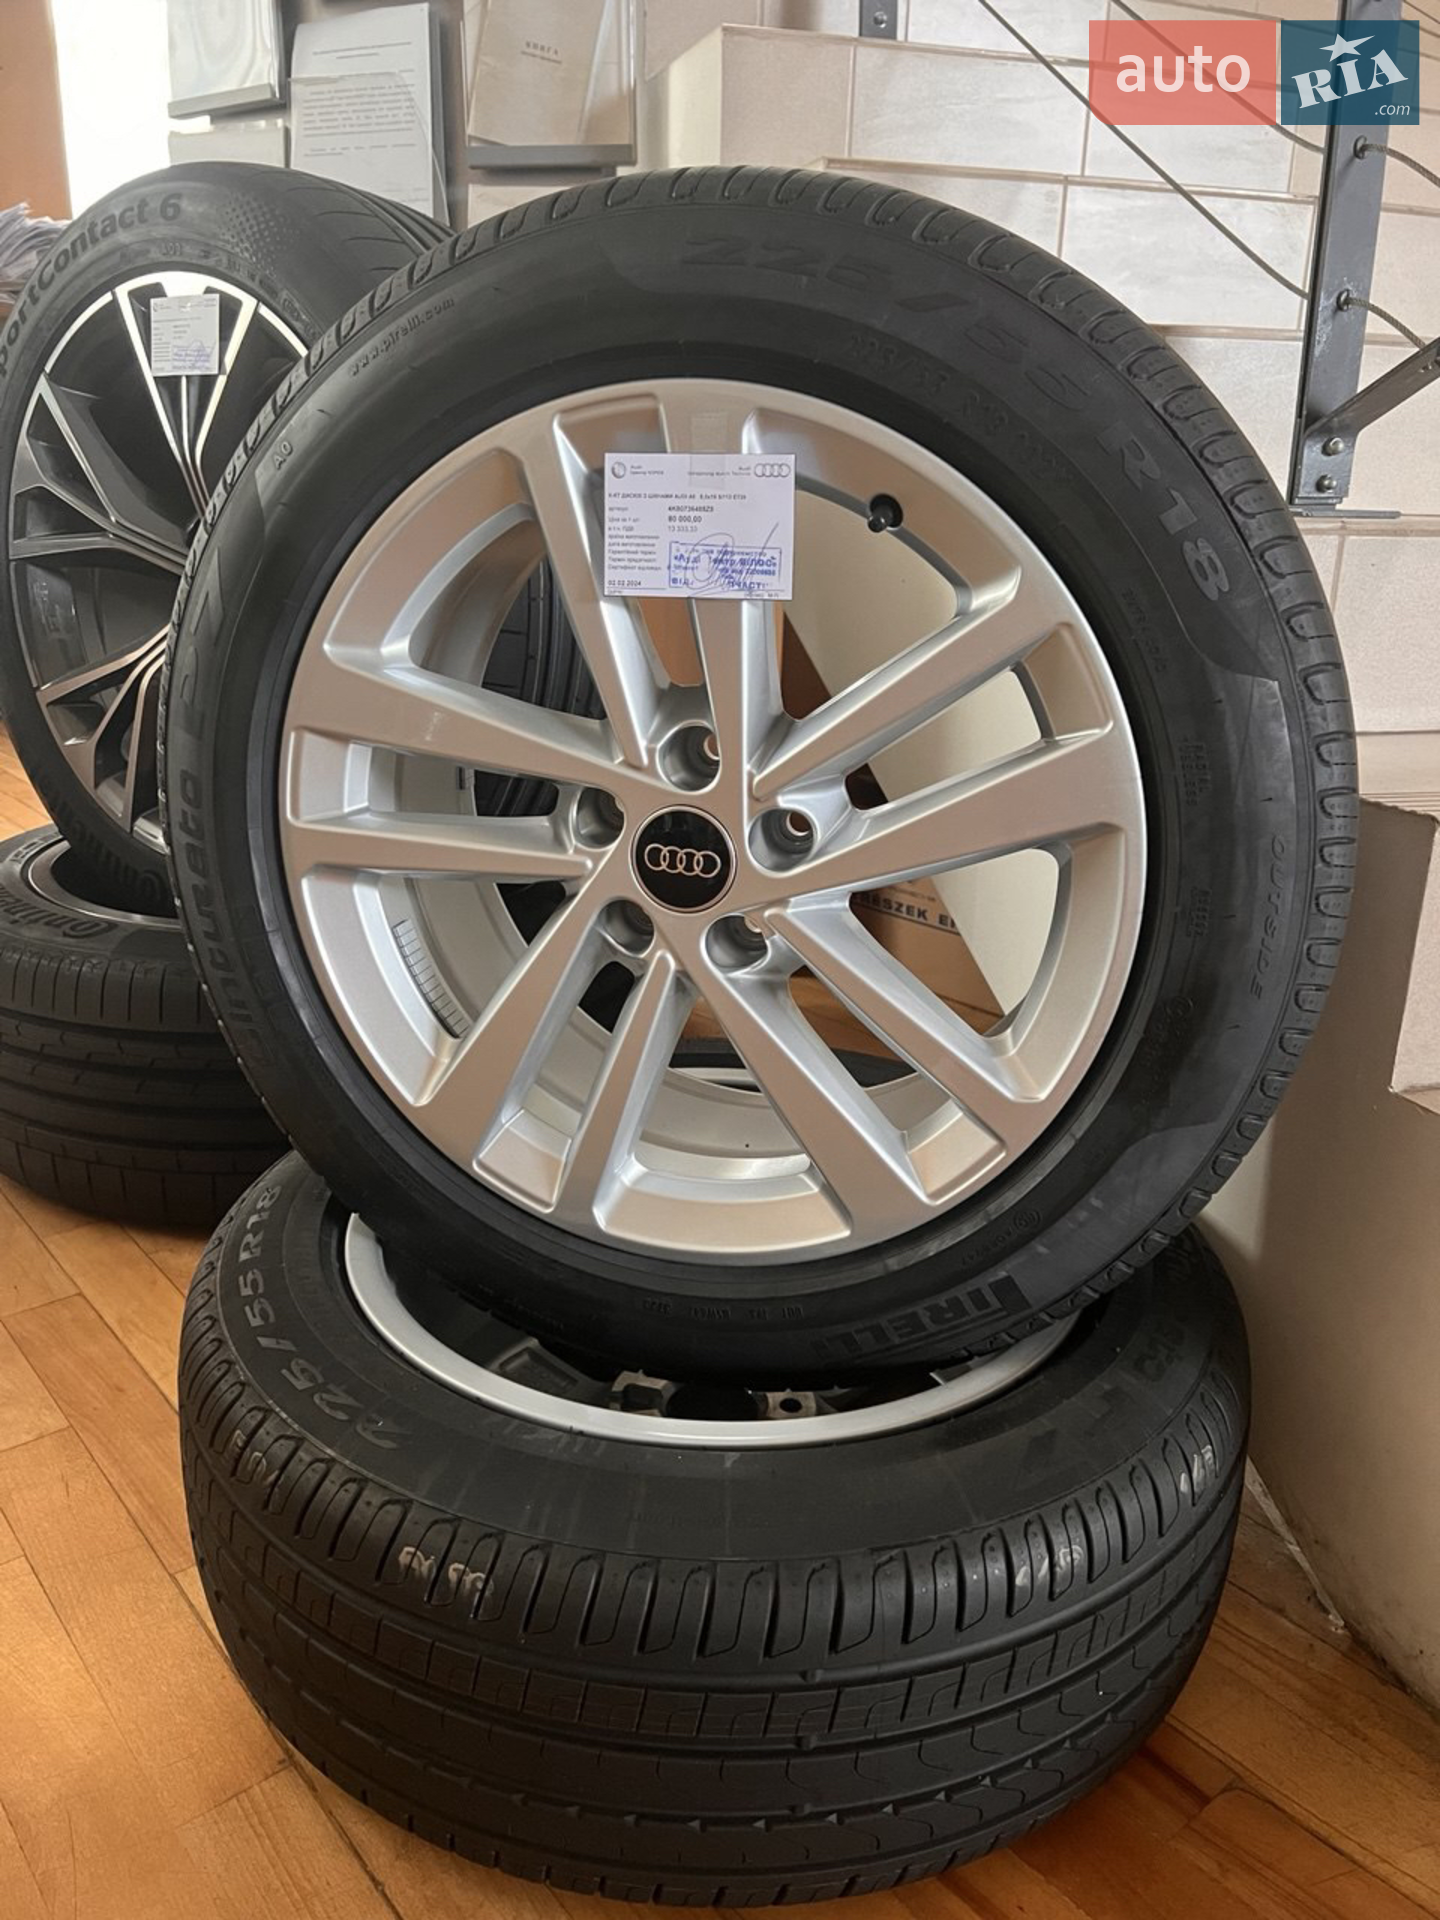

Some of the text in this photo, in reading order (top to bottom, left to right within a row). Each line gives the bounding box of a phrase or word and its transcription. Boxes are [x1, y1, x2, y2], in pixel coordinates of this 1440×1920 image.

[0, 202, 149, 378] portContact
[159, 192, 183, 222] 6
[351, 298, 455, 376] www.pirelli.com
[1248, 835, 1288, 999] OUTSIDE
[809, 1273, 1034, 1362] PIRELLI
